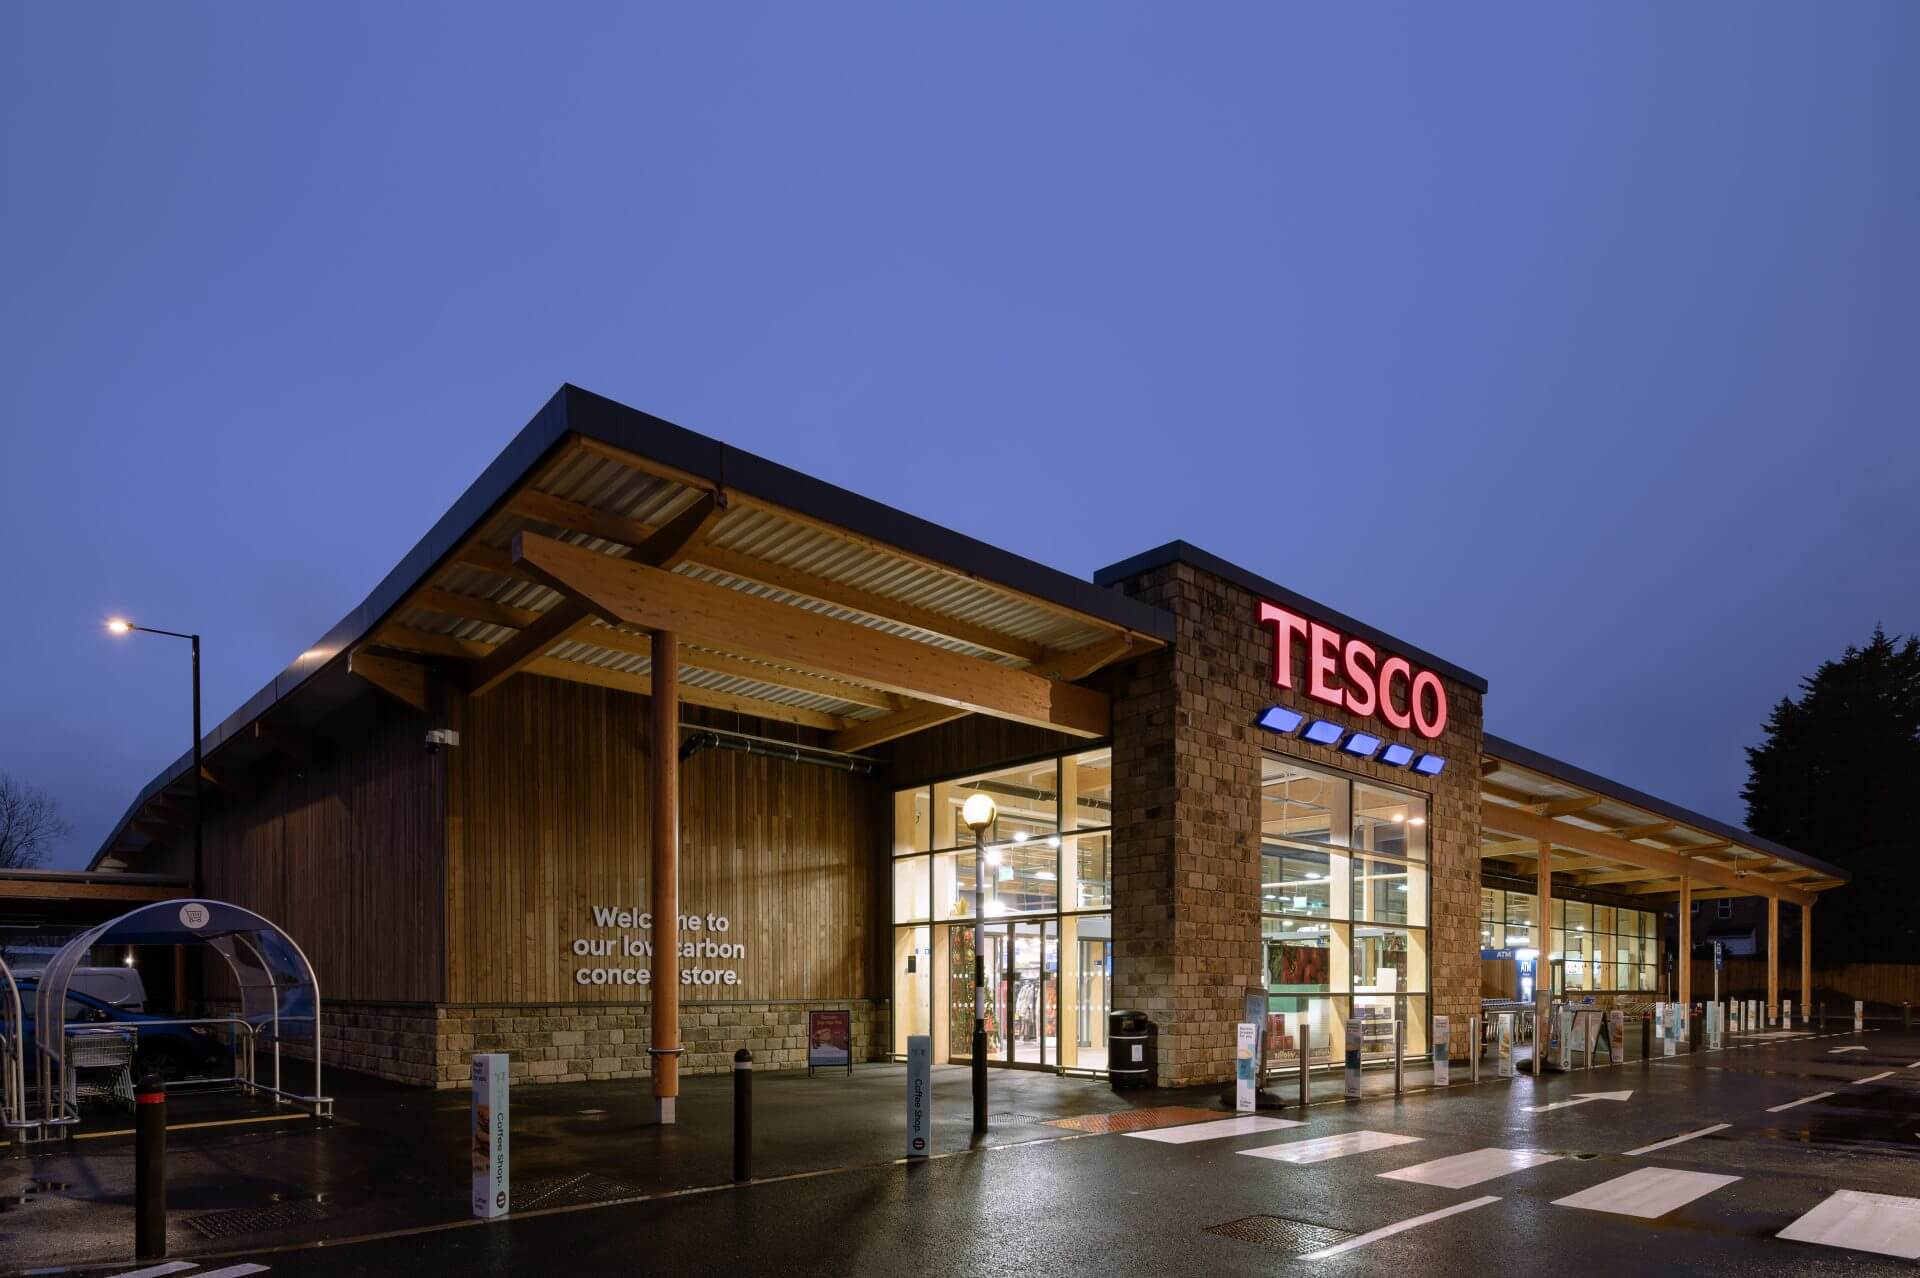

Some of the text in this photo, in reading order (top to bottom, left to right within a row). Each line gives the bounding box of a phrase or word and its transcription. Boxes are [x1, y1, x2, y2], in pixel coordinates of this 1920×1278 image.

[1259, 601, 1448, 739] TESCO
[706, 912, 729, 932] to
[573, 938, 616, 956] our
[681, 966, 742, 985] store.
[496, 1112, 505, 1152] Coffee
